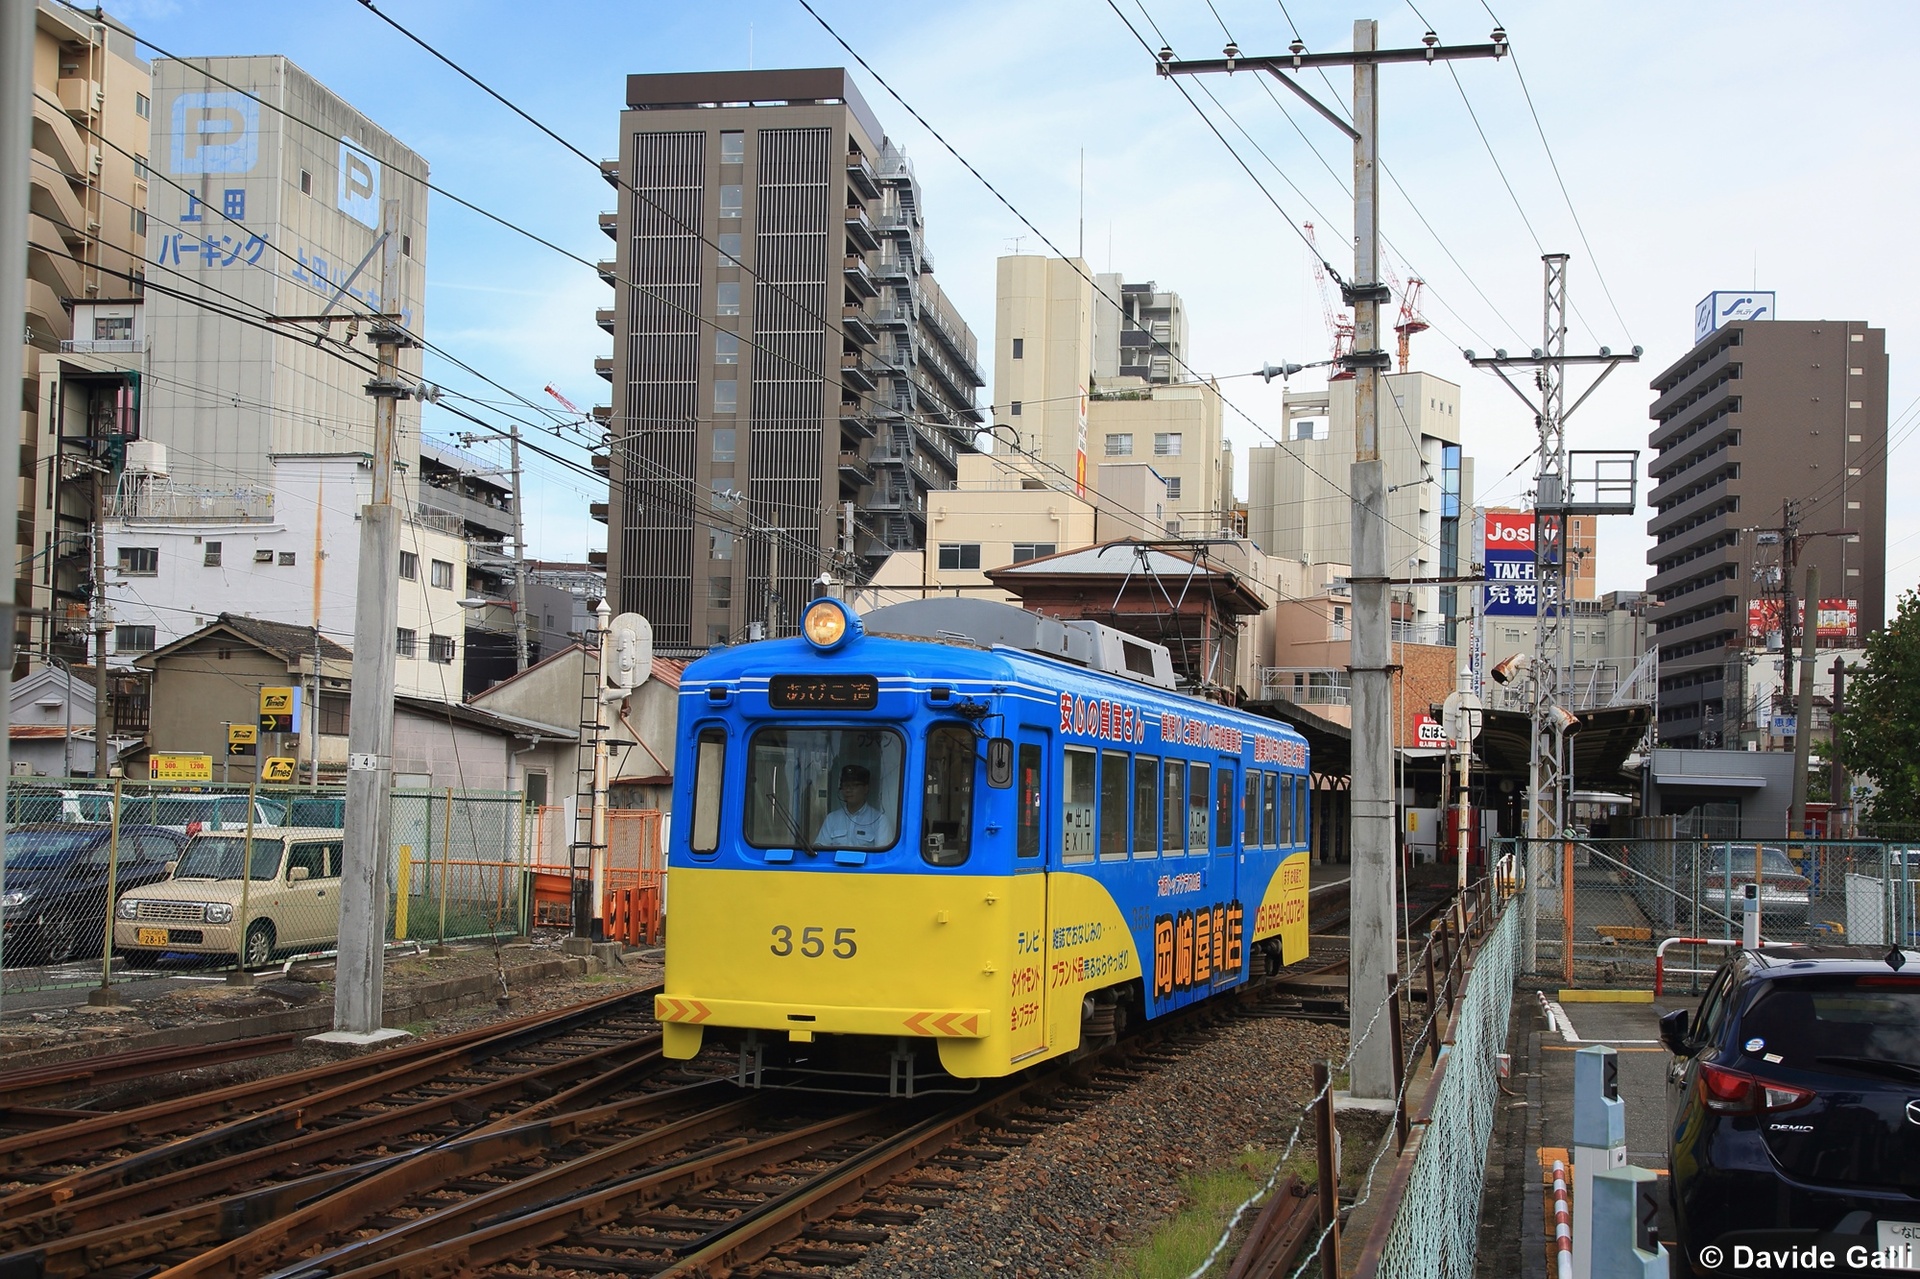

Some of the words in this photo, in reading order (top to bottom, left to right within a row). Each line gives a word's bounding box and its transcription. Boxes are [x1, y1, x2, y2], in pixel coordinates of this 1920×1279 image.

[180, 188, 246, 221] 上田
[158, 232, 269, 268] パーキング
[292, 247, 413, 329] 上田パーキグ
[1487, 522, 1560, 542] Jos
[265, 695, 288, 707] Times
[1060, 691, 1144, 744] 安心の質屋さん
[270, 761, 294, 777] Times
[363, 757, 369, 767] 4
[1076, 808, 1090, 828] 出口
[1065, 832, 1091, 850] EXIT
[770, 925, 857, 959] 355
[1769, 1123, 1814, 1133] DEMIO
